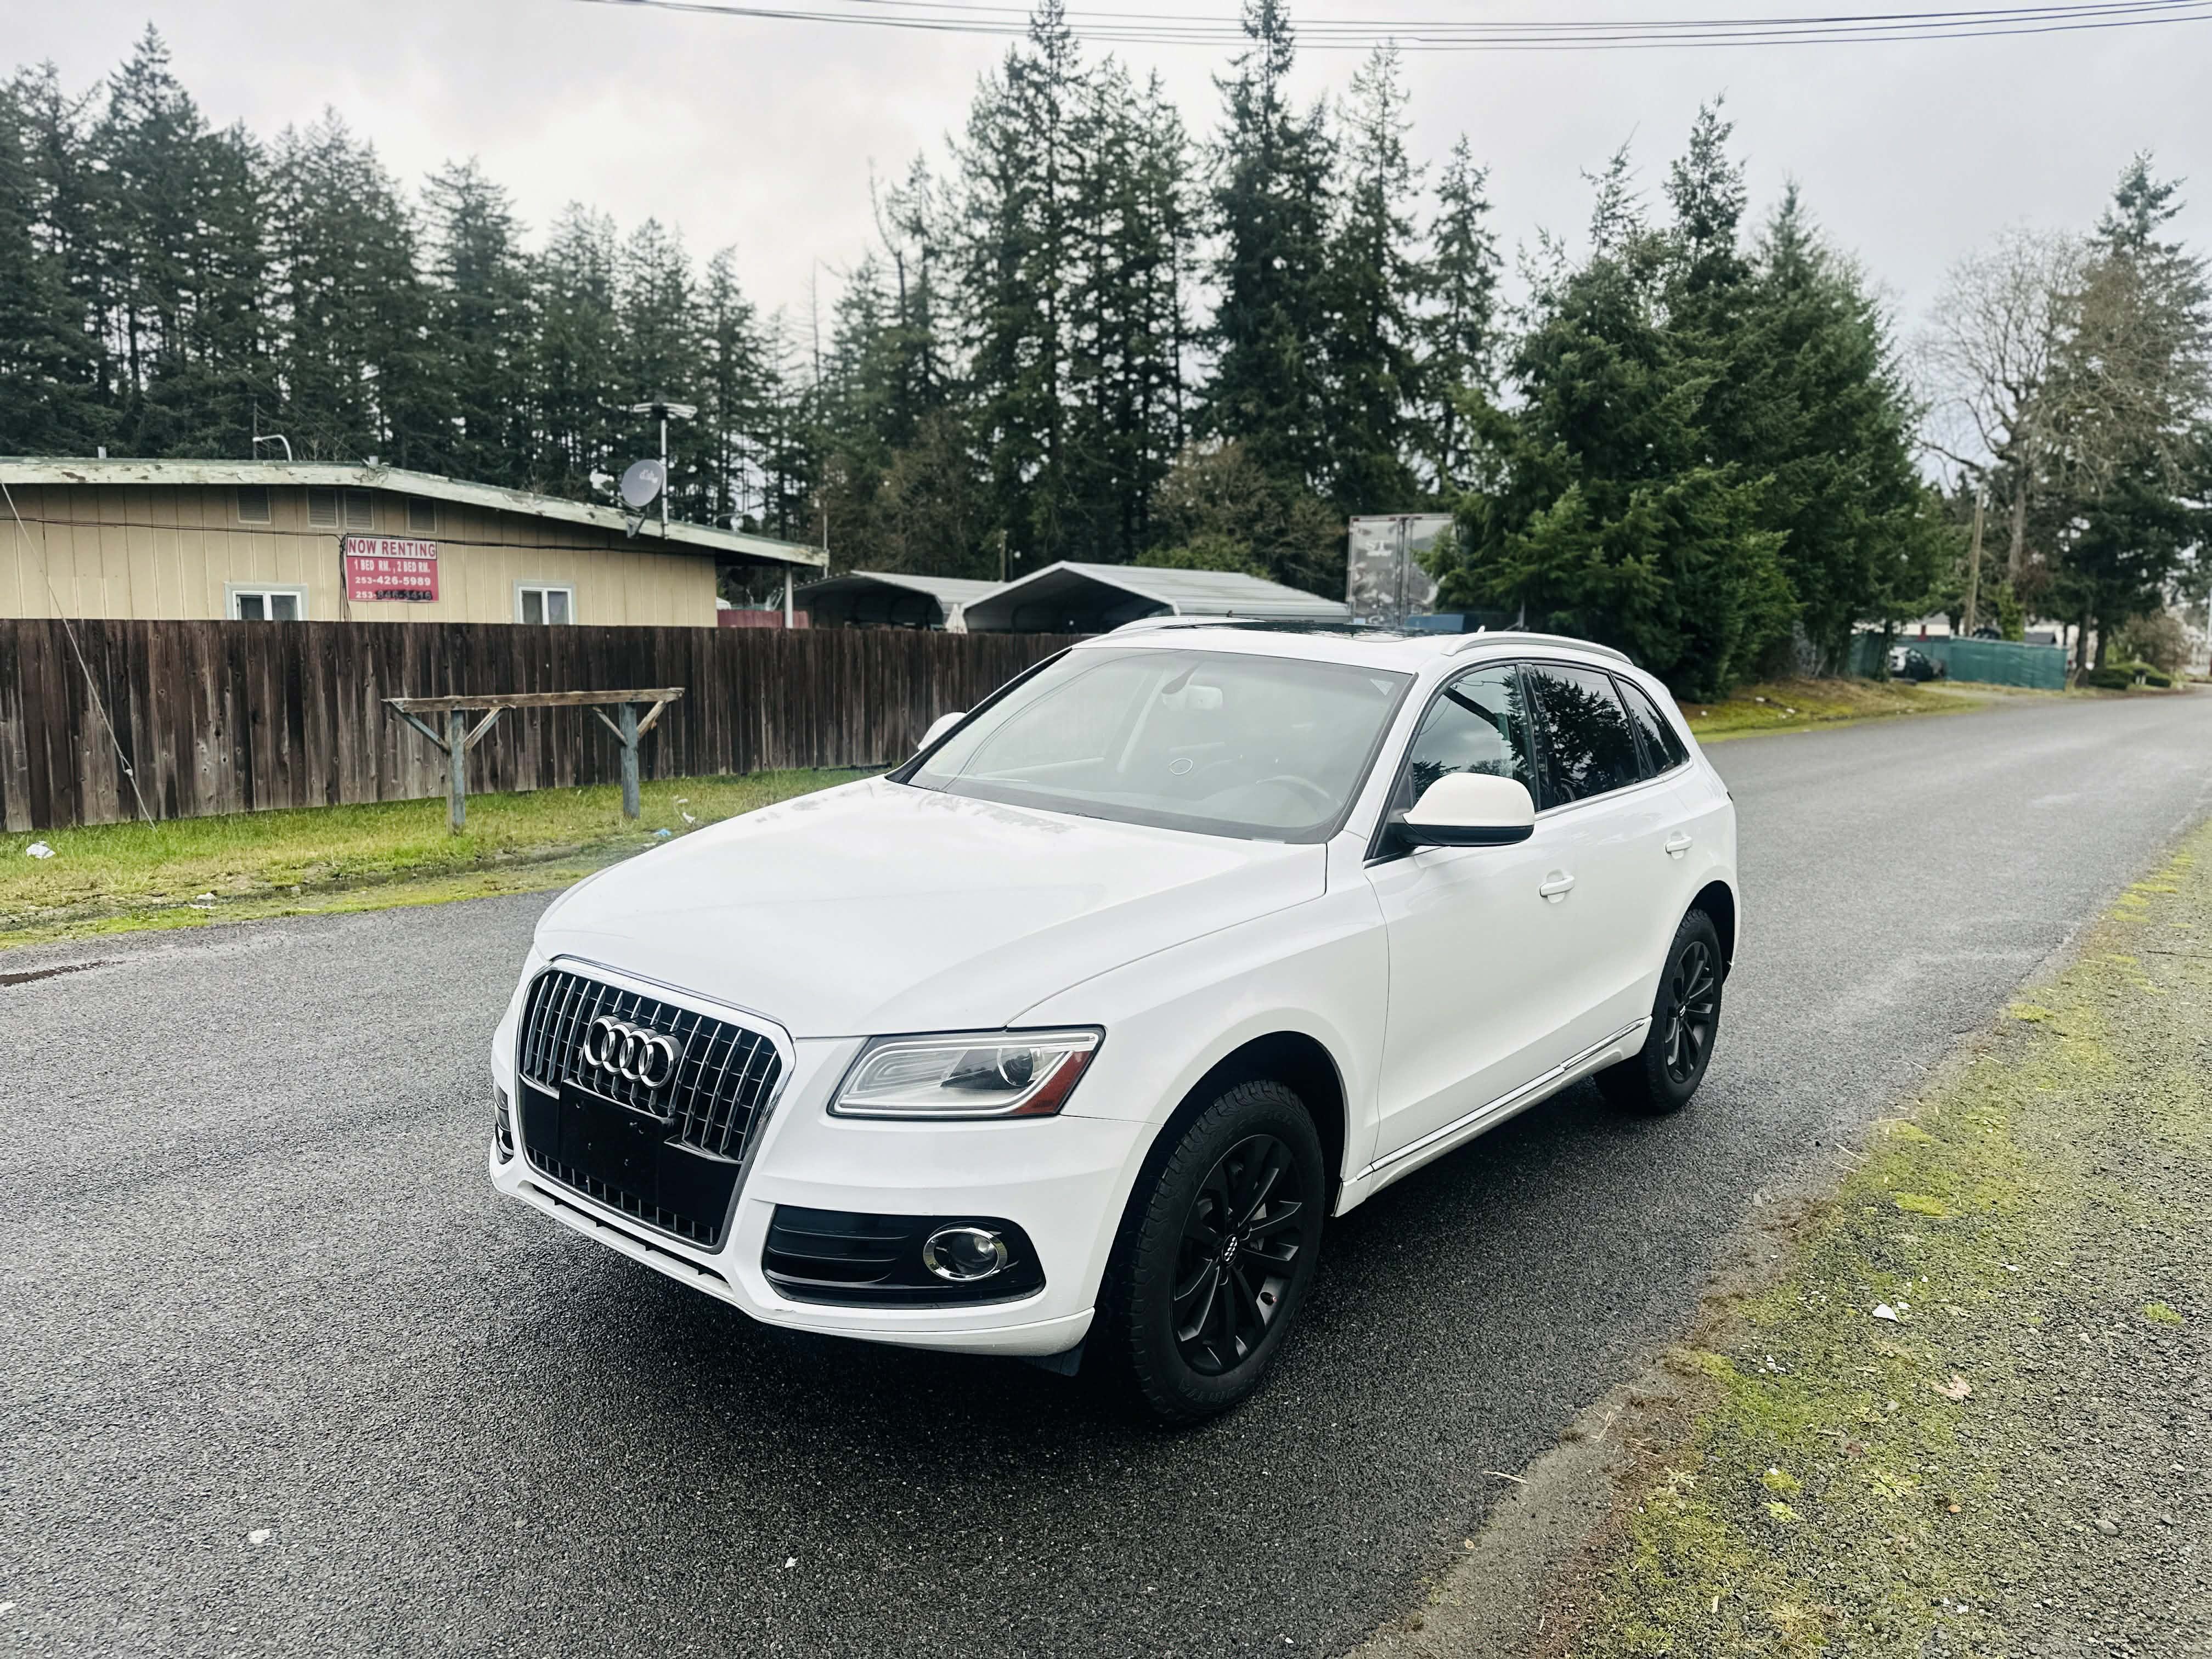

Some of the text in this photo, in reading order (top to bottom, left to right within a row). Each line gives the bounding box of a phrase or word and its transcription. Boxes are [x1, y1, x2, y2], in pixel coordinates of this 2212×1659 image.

[348, 539, 436, 557] NOW RENTING
[354, 559, 358, 571] 1
[360, 560, 374, 571] BED
[397, 561, 402, 572] 2
[403, 561, 416, 573] BED
